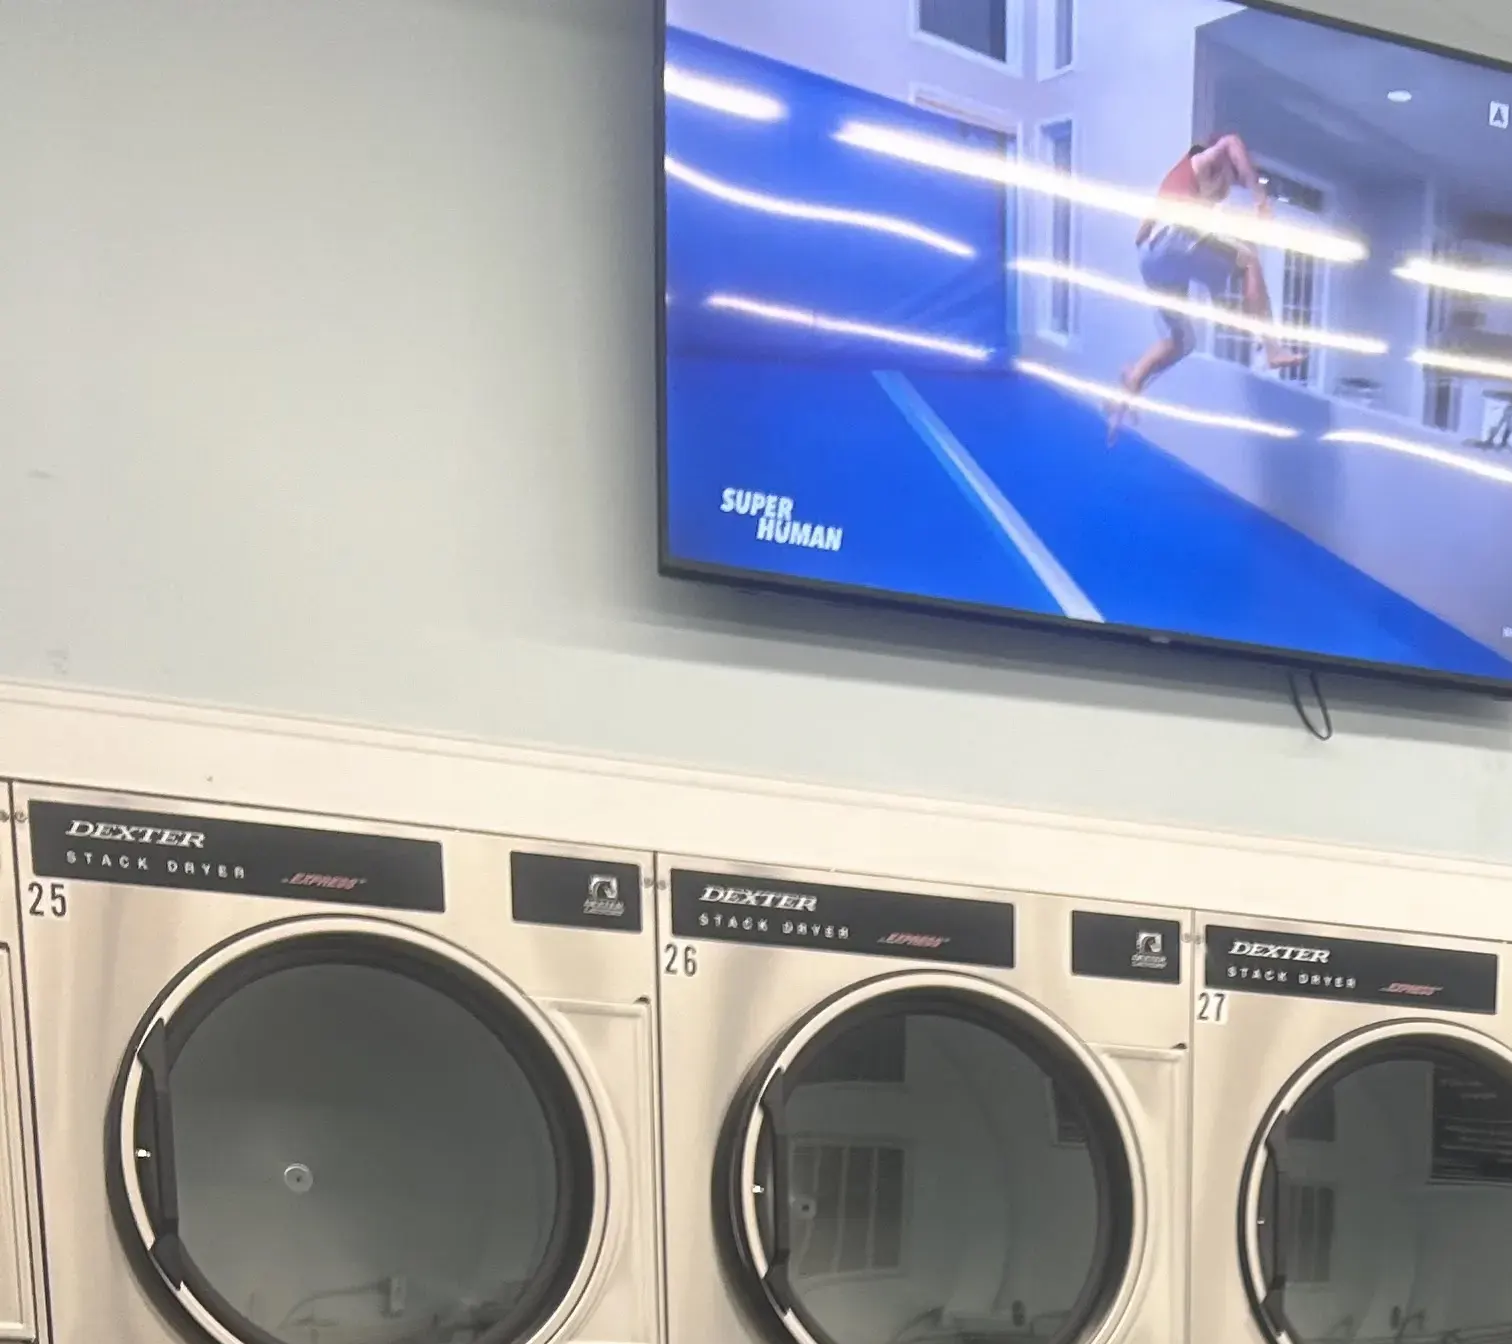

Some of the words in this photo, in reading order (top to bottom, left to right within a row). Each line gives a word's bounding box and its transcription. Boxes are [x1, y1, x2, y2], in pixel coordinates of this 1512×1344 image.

[720, 487, 794, 520] SUPER
[756, 516, 843, 552] HUMAN
[65, 819, 206, 848] DEXTER
[66, 851, 148, 871] STACK
[167, 860, 245, 879] DRYER
[28, 882, 67, 917] 25
[699, 885, 818, 912] DEXTER
[699, 913, 768, 932] STACK
[664, 943, 697, 977] 26
[1228, 940, 1331, 964] DEXTER
[1227, 966, 1288, 982] STACK
[1299, 973, 1357, 989] DRYER
[1196, 992, 1226, 1022] 27
